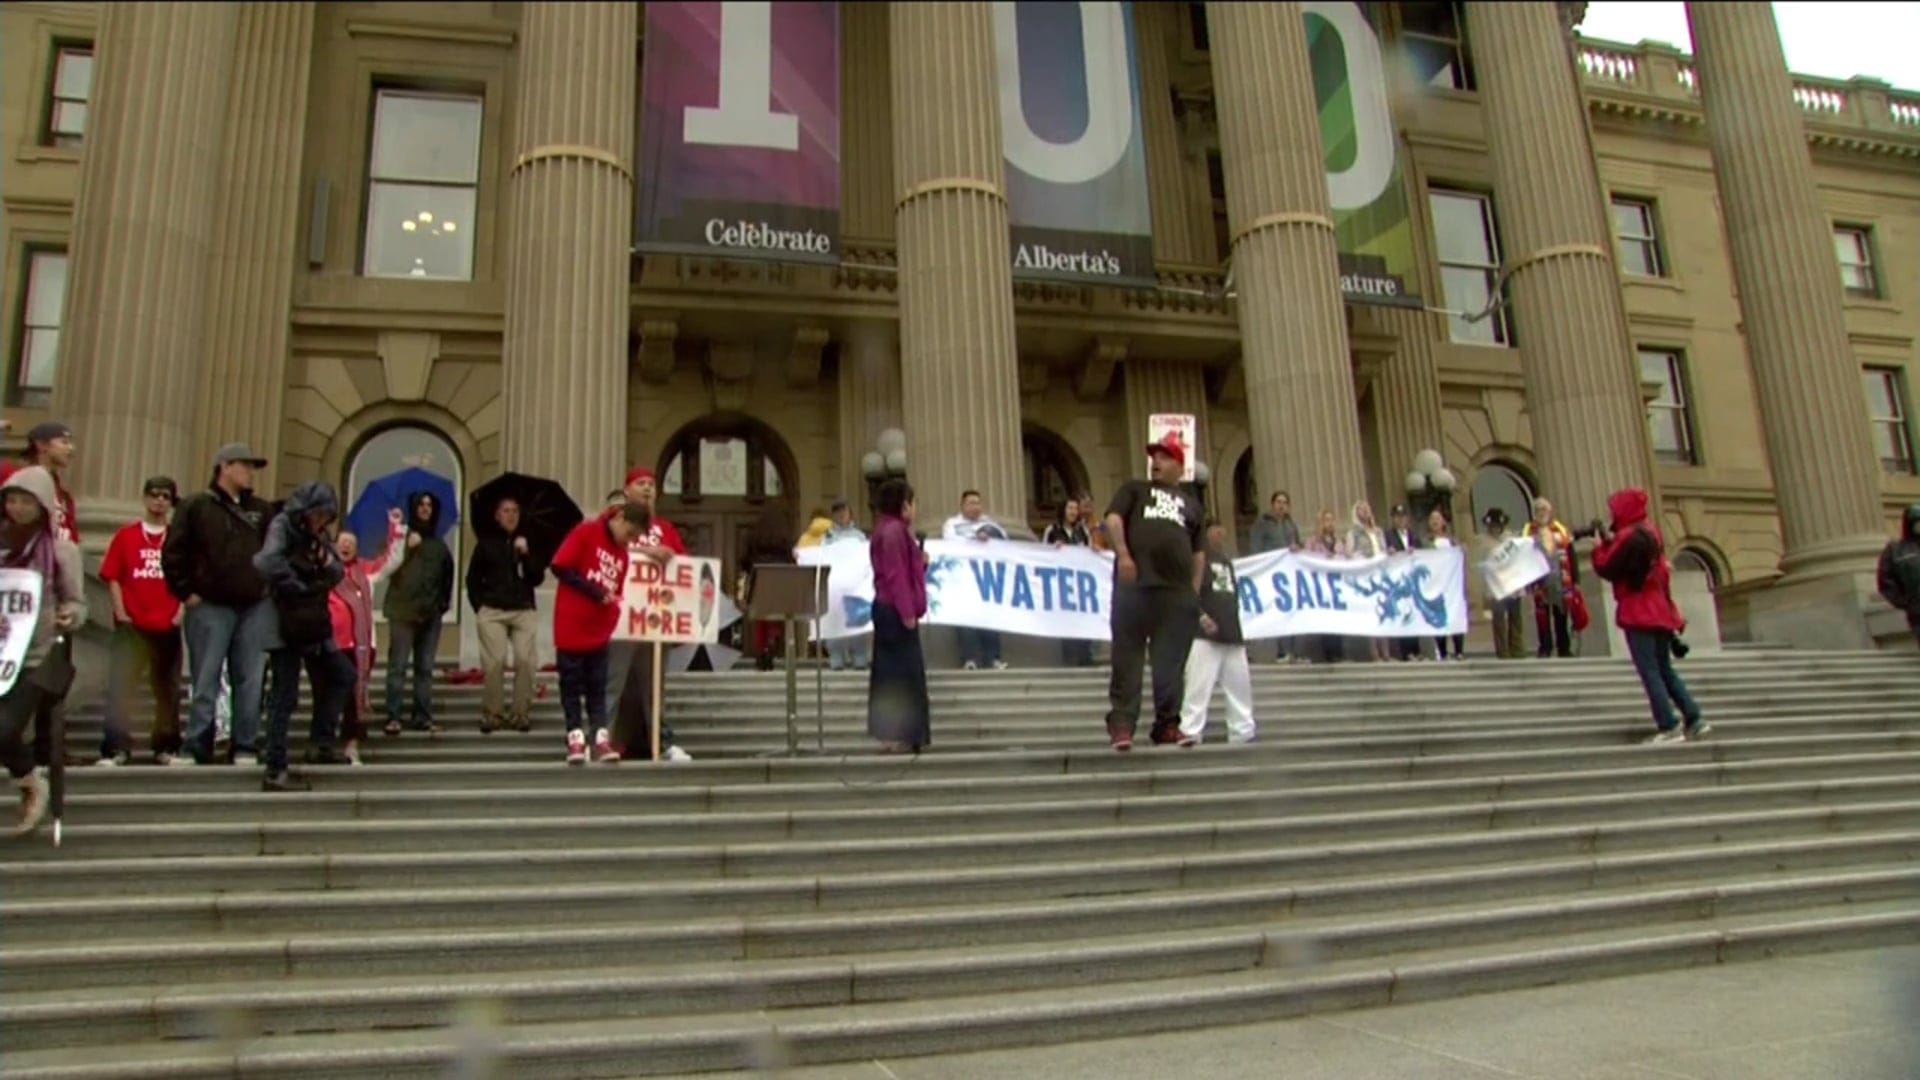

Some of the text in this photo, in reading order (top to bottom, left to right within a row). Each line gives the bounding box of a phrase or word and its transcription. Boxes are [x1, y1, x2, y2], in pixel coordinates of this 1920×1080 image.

[704, 218, 831, 253] Celebrate
[1014, 243, 1120, 275] Alberta's
[1339, 273, 1398, 297] ature
[630, 560, 692, 589] IDLE
[968, 558, 1099, 613] WATER
[647, 586, 674, 606] NO
[1271, 570, 1347, 613] SALE
[629, 605, 692, 635] MORE
